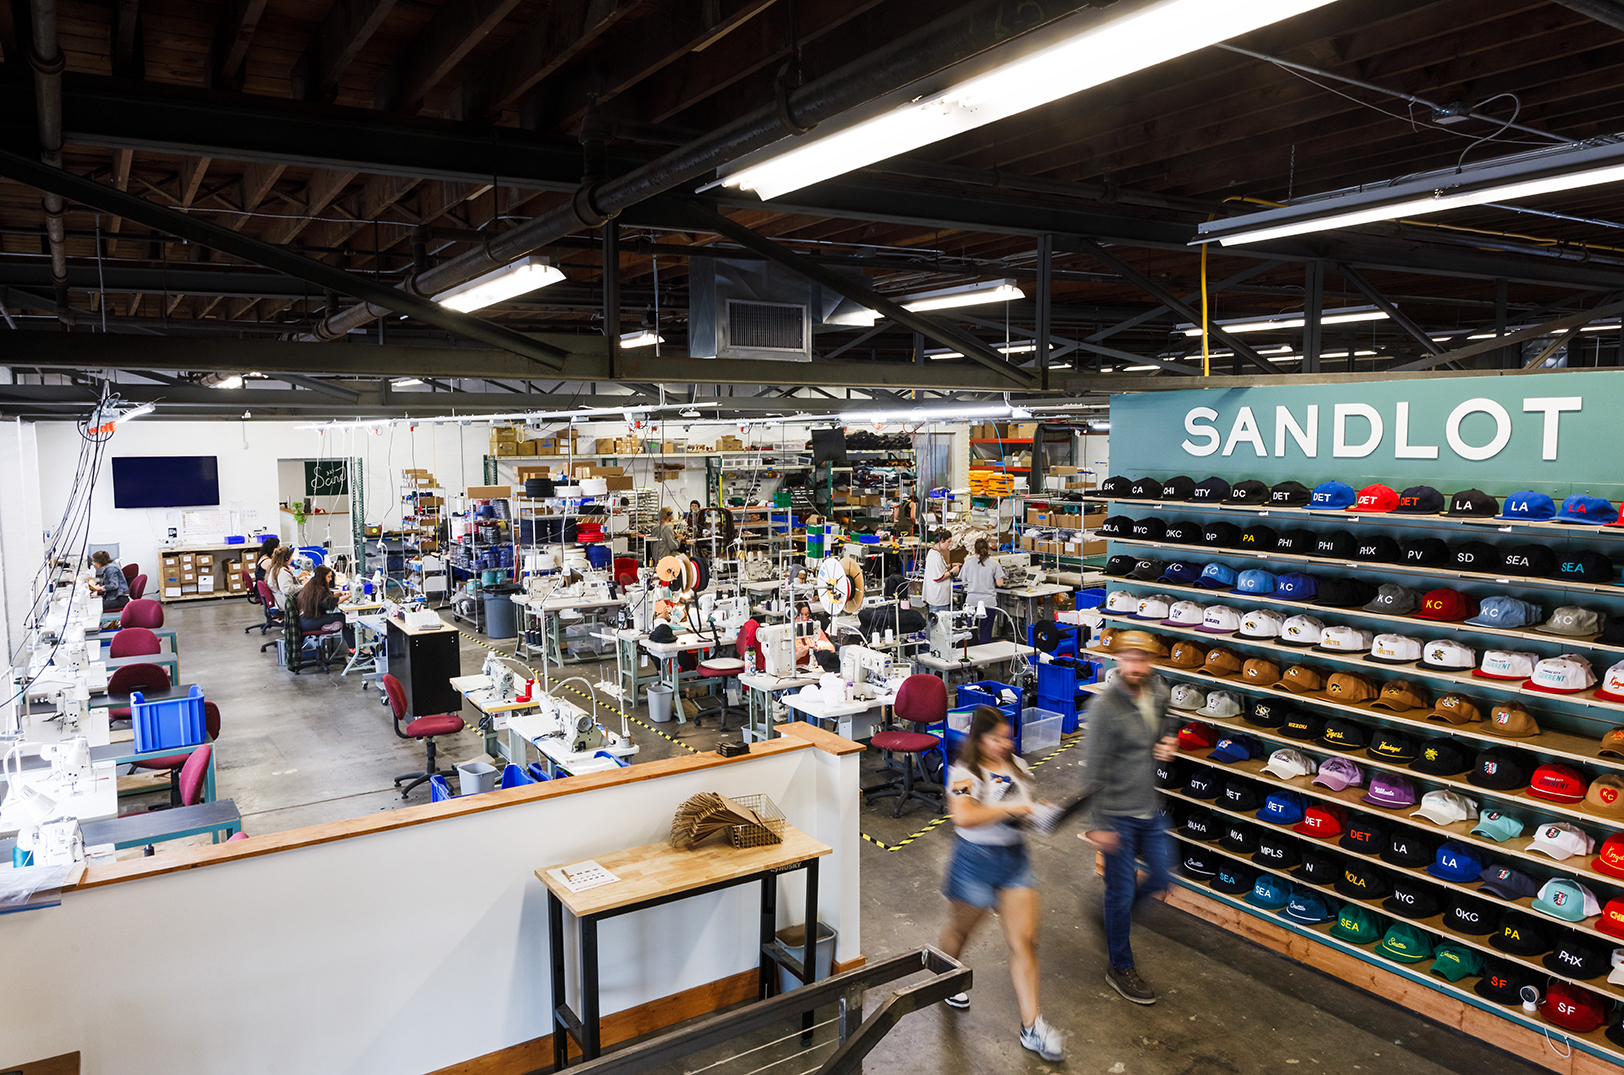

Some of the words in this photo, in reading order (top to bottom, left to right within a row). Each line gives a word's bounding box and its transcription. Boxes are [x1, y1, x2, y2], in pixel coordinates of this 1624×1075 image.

[1181, 396, 1583, 460] SANDLOT
[1132, 486, 1143, 494] CA
[1163, 487, 1174, 495] CHI
[1233, 490, 1246, 498] DC
[1273, 491, 1290, 500] DET
[1313, 493, 1331, 502] DET
[1358, 495, 1377, 505] DET
[1400, 497, 1419, 506] DET
[1456, 500, 1472, 510] LA
[1511, 501, 1529, 512] LA
[1568, 503, 1586, 513] LA
[1133, 526, 1148, 534] NYC
[1166, 530, 1182, 538] OKC
[1206, 533, 1217, 541] OP
[1243, 534, 1254, 542] PA
[1278, 538, 1292, 548] PHI
[1318, 541, 1334, 550] PHI
[1360, 546, 1376, 555] PHX
[1408, 550, 1423, 560] PV
[1457, 553, 1474, 563] SD
[1506, 555, 1529, 566] SEA
[1561, 562, 1584, 573] SEA
[1241, 578, 1255, 588] KC
[1280, 581, 1293, 591] KC
[1377, 594, 1393, 604] KC
[1426, 600, 1443, 610] KC
[1481, 606, 1499, 617] KC
[1553, 614, 1573, 625] KC
[1486, 661, 1511, 670] CURRENT
[1538, 672, 1565, 681] CURRENT
[1157, 769, 1168, 779] CHI
[1539, 779, 1570, 789] CURRENT
[1226, 789, 1241, 800] DET
[1602, 791, 1613, 800] KC
[1267, 801, 1284, 813] DET
[1305, 816, 1322, 827] DET
[1230, 830, 1243, 842] MIA
[1350, 829, 1371, 842] DET
[1261, 846, 1283, 858] MPLS
[1394, 842, 1408, 854] LA
[1442, 855, 1458, 868] LA
[1306, 863, 1313, 872] N
[1220, 872, 1235, 884] SEA
[1345, 870, 1366, 887] NOLA
[1255, 885, 1271, 898] SEA
[1395, 890, 1415, 904] NYC
[1455, 908, 1479, 922] OKC
[1340, 917, 1359, 932] SEA
[1504, 927, 1520, 940] PA
[1388, 937, 1407, 949] Seattle
[1559, 950, 1583, 967] PHX
[1491, 976, 1507, 988] SF
[1558, 1002, 1576, 1015] SF
